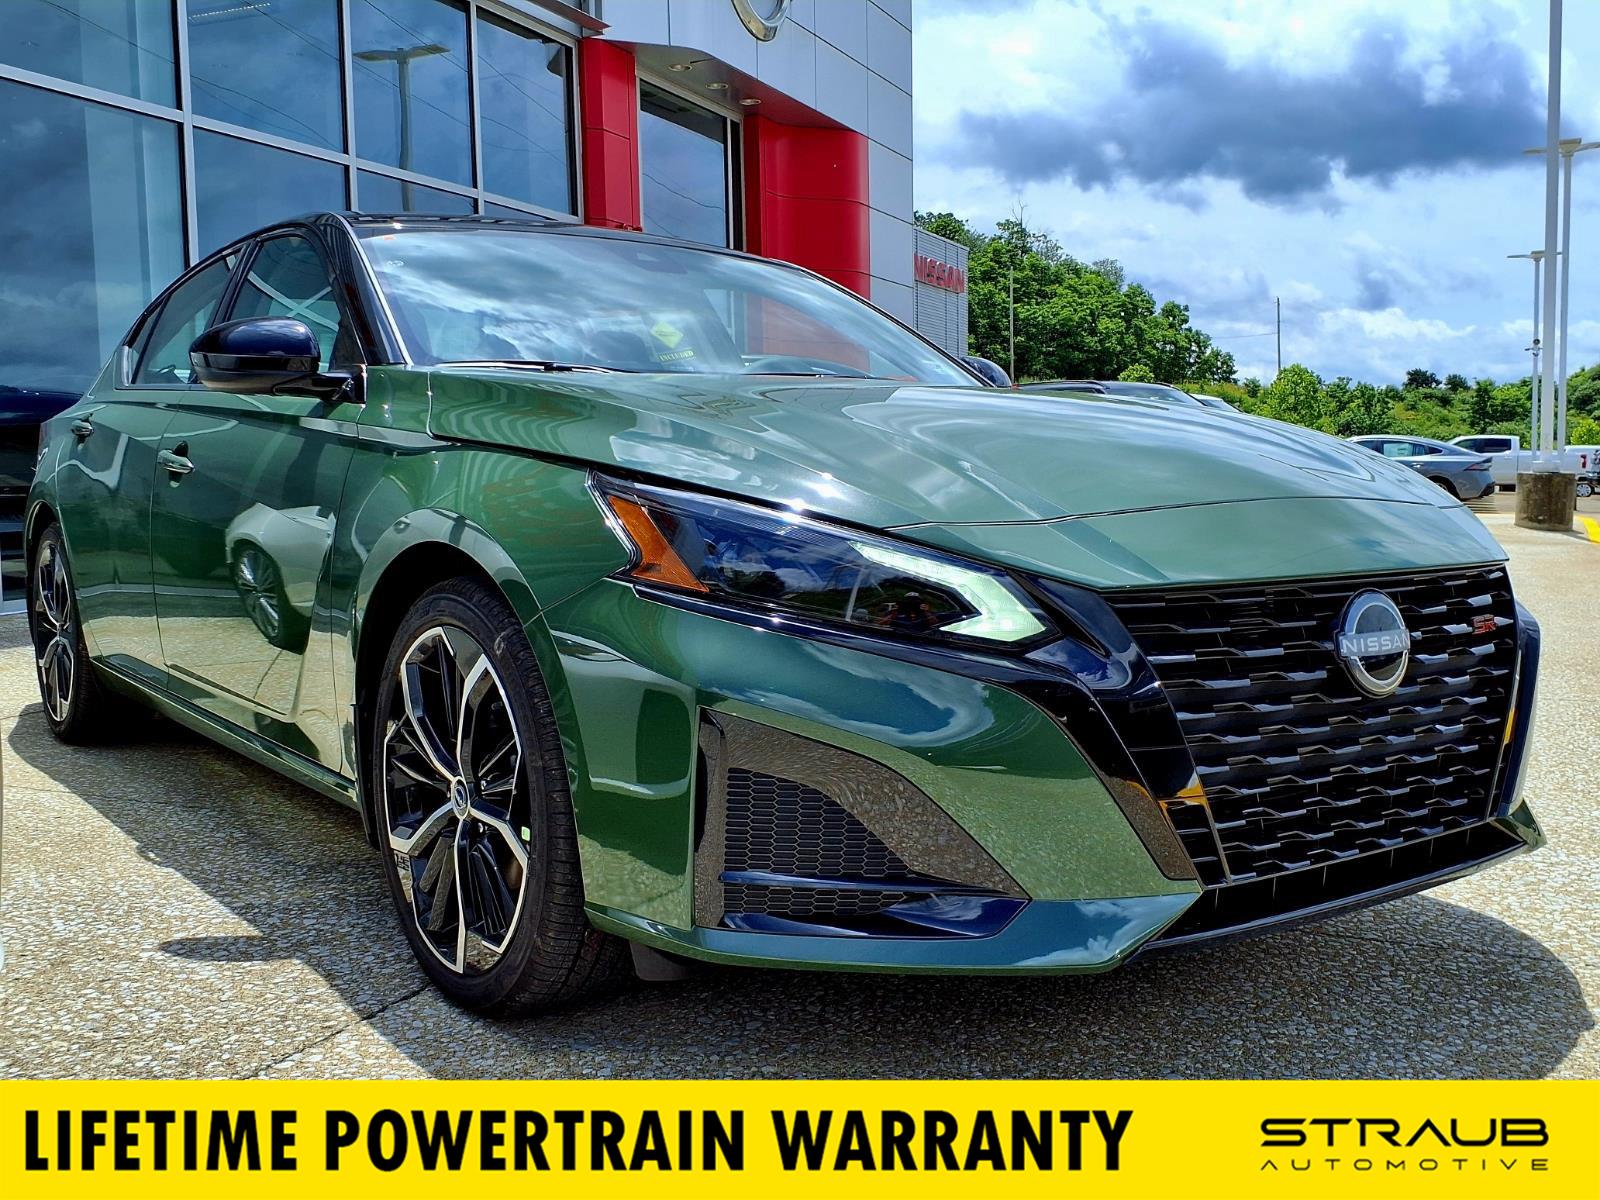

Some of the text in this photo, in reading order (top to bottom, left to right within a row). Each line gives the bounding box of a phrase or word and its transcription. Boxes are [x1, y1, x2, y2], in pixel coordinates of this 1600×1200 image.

[914, 252, 964, 293] NISSAN
[1472, 615, 1497, 635] SR
[1342, 635, 1410, 653] NISSAN
